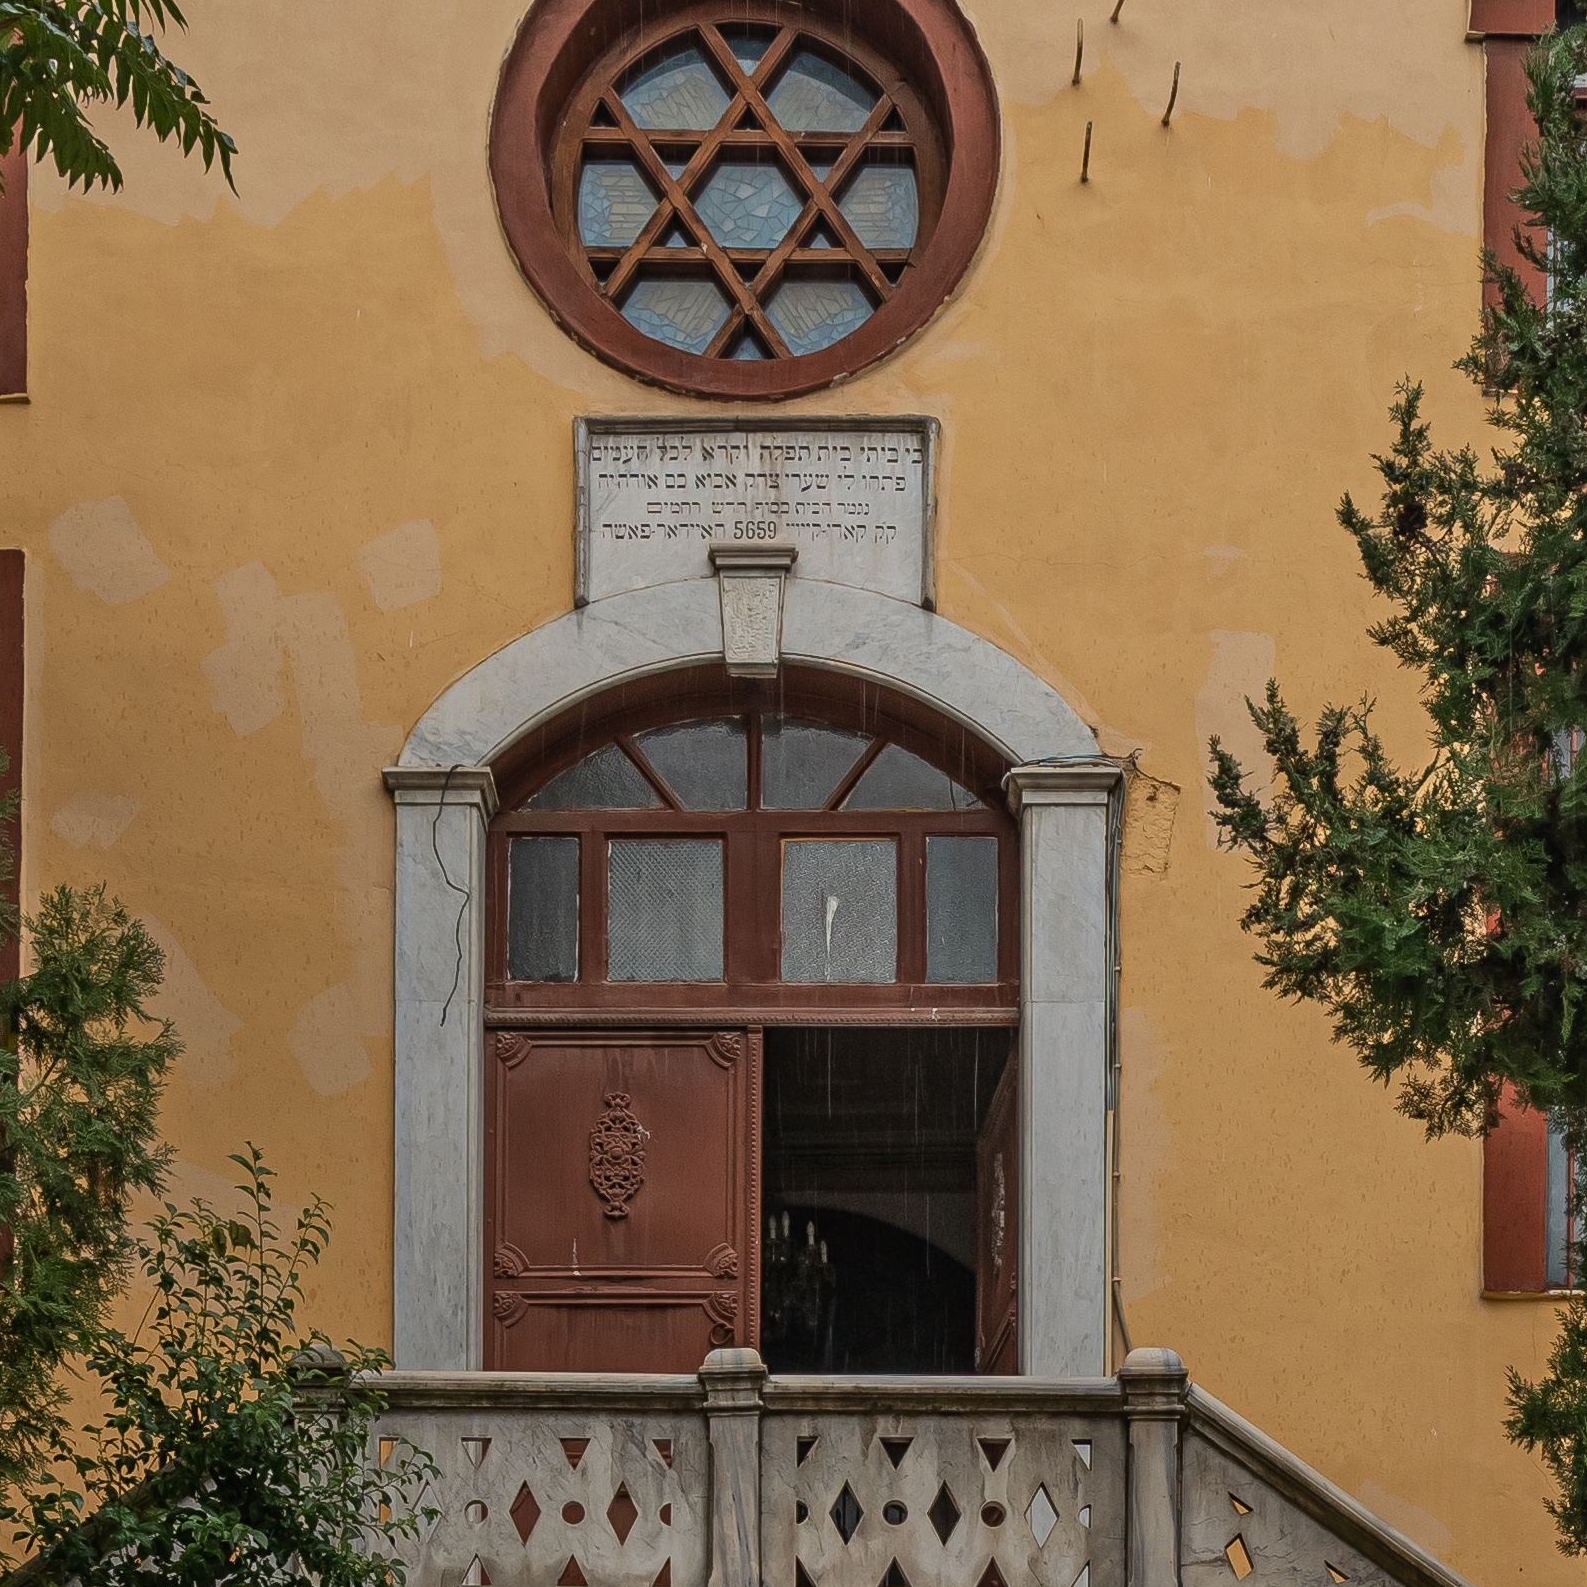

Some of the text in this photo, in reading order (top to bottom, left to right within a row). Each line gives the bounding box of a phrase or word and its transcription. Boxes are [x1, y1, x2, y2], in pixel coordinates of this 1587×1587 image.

[656, 437, 693, 462] לכל
[759, 437, 811, 462] תפלה
[817, 445, 852, 462] בית
[859, 446, 899, 463] ביתי
[904, 447, 923, 464] כי
[694, 472, 737, 489] אבוא
[744, 473, 780, 492] צדק
[784, 473, 830, 492] שערי
[836, 466, 855, 490] לי
[861, 474, 906, 491] פתחו
[646, 501, 702, 515] רחמים
[794, 501, 832, 515] הבית
[733, 521, 777, 540] 5659
